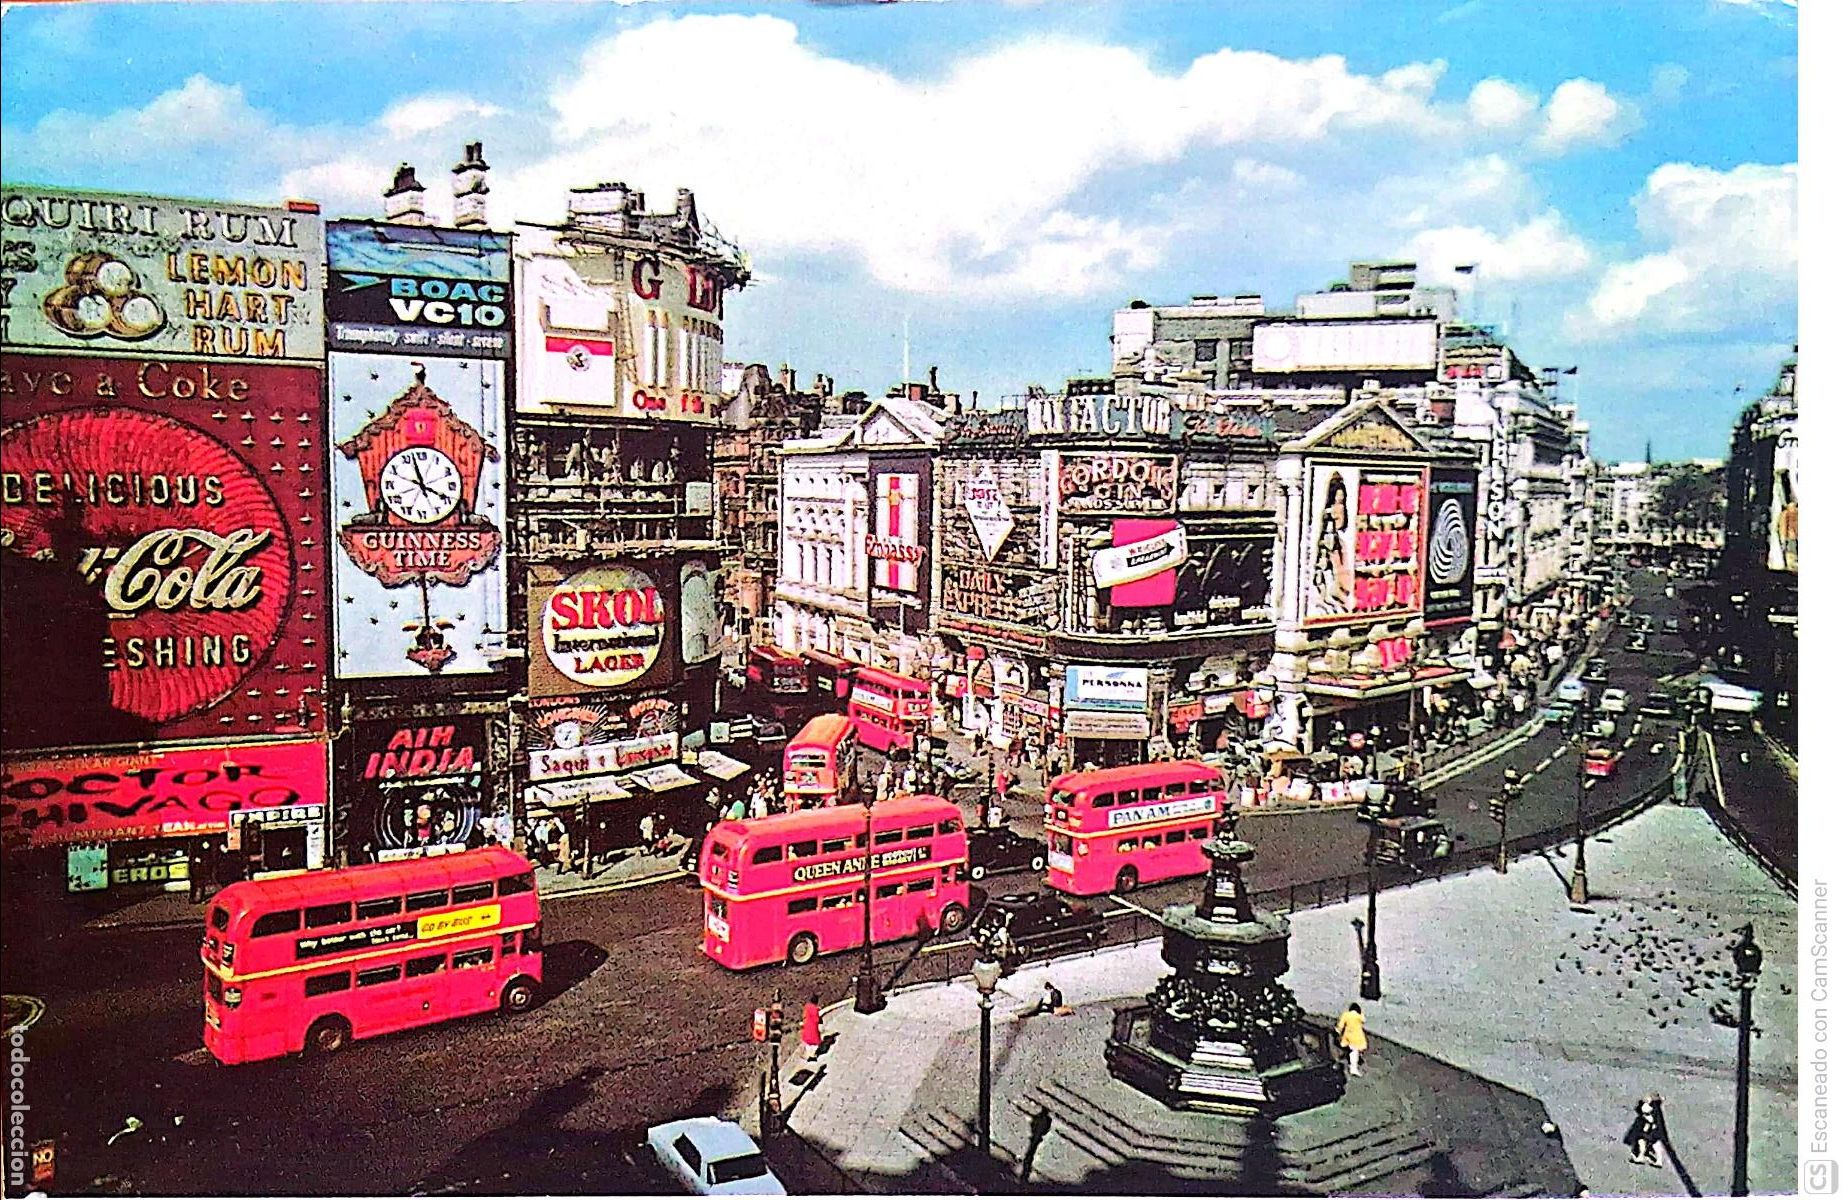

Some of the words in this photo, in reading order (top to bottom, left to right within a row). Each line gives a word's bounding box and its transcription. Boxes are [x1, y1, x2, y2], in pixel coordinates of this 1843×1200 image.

[1, 196, 158, 237] QUIRI
[178, 207, 298, 248] RUM
[167, 252, 308, 291] LEMON
[391, 278, 505, 302] BOAC
[186, 289, 295, 325] HART
[389, 298, 506, 327] VC10
[192, 324, 287, 359] RUM
[97, 375, 118, 397] a
[138, 361, 251, 400] Coke
[1070, 394, 1170, 436] FACTOR
[1094, 482, 1142, 500] GIN
[362, 531, 481, 550] GUINNESS
[865, 533, 927, 567] Embassy
[105, 528, 270, 611] Cola
[393, 551, 451, 568] TIME
[551, 586, 665, 630] SKOL
[943, 588, 1019, 620] EXPRE
[573, 653, 645, 673] LAGER
[1082, 679, 1142, 687] PERSONNA
[364, 746, 473, 778] INDIA
[2, 764, 291, 799] OCTOR
[2, 787, 299, 828] HIVAGO
[233, 806, 321, 829] EMPIRE
[1113, 809, 1143, 824] PAN
[1147, 806, 1170, 819] AM
[112, 862, 189, 883] ERO
[794, 861, 841, 881] QUEEN
[32, 1148, 54, 1166] NO
